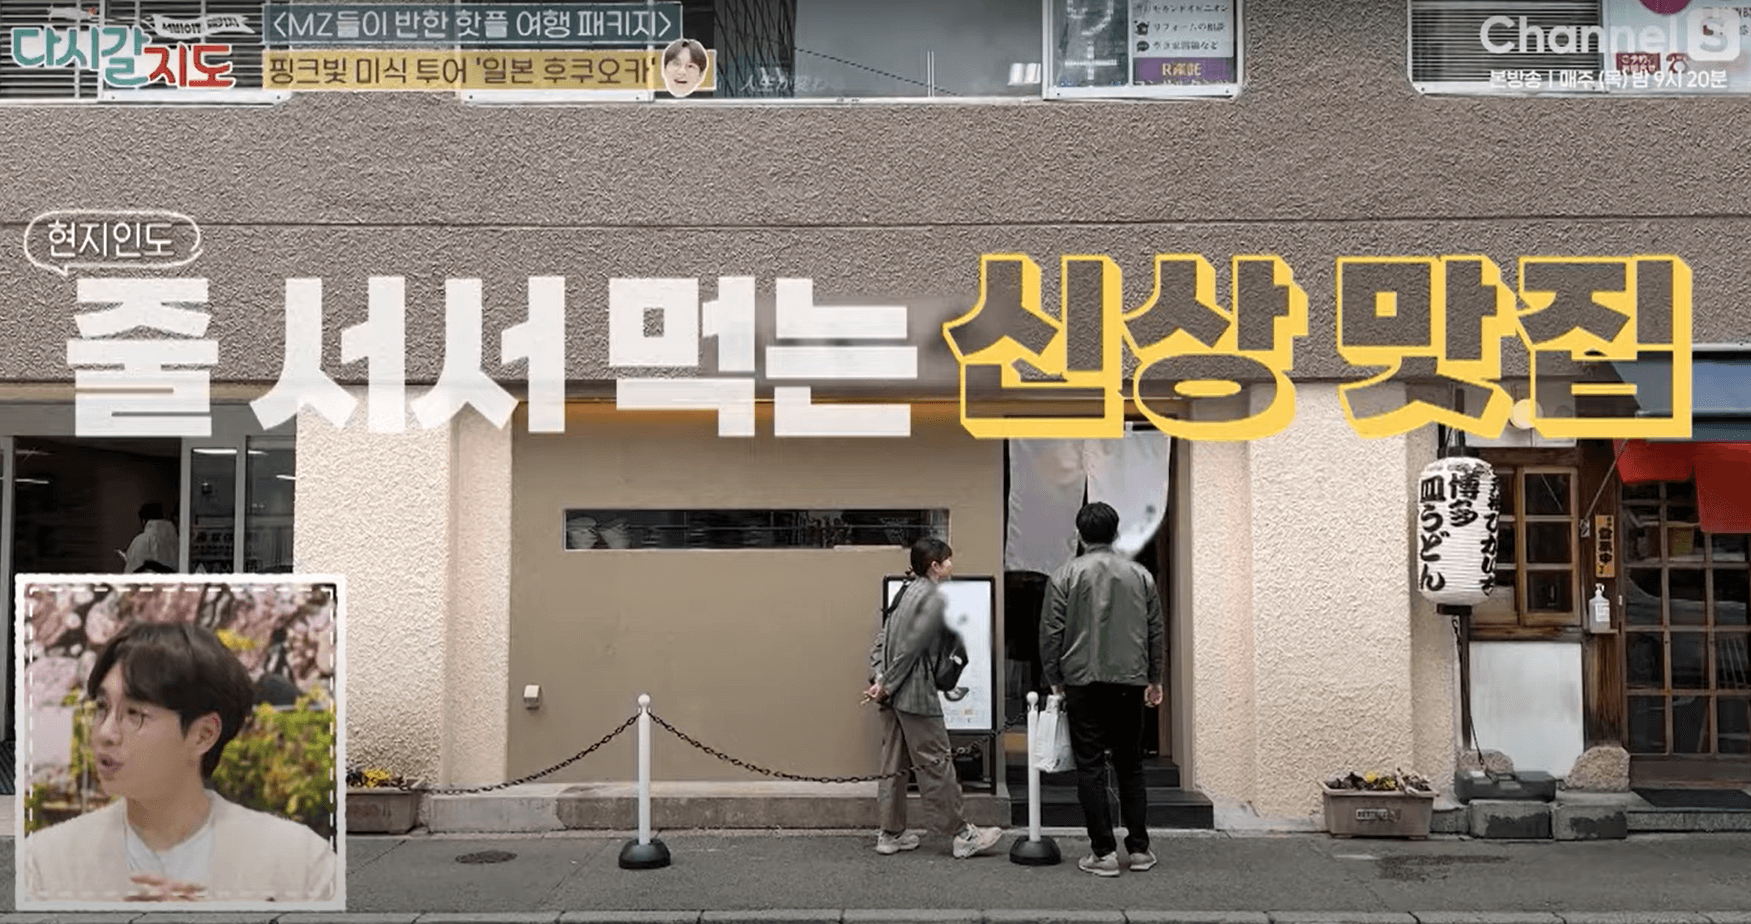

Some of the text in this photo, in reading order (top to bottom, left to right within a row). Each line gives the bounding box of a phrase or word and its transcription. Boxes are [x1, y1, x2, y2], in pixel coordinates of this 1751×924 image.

[1420, 474, 1450, 592] 皿うどん
[1448, 470, 1481, 527] 博多
